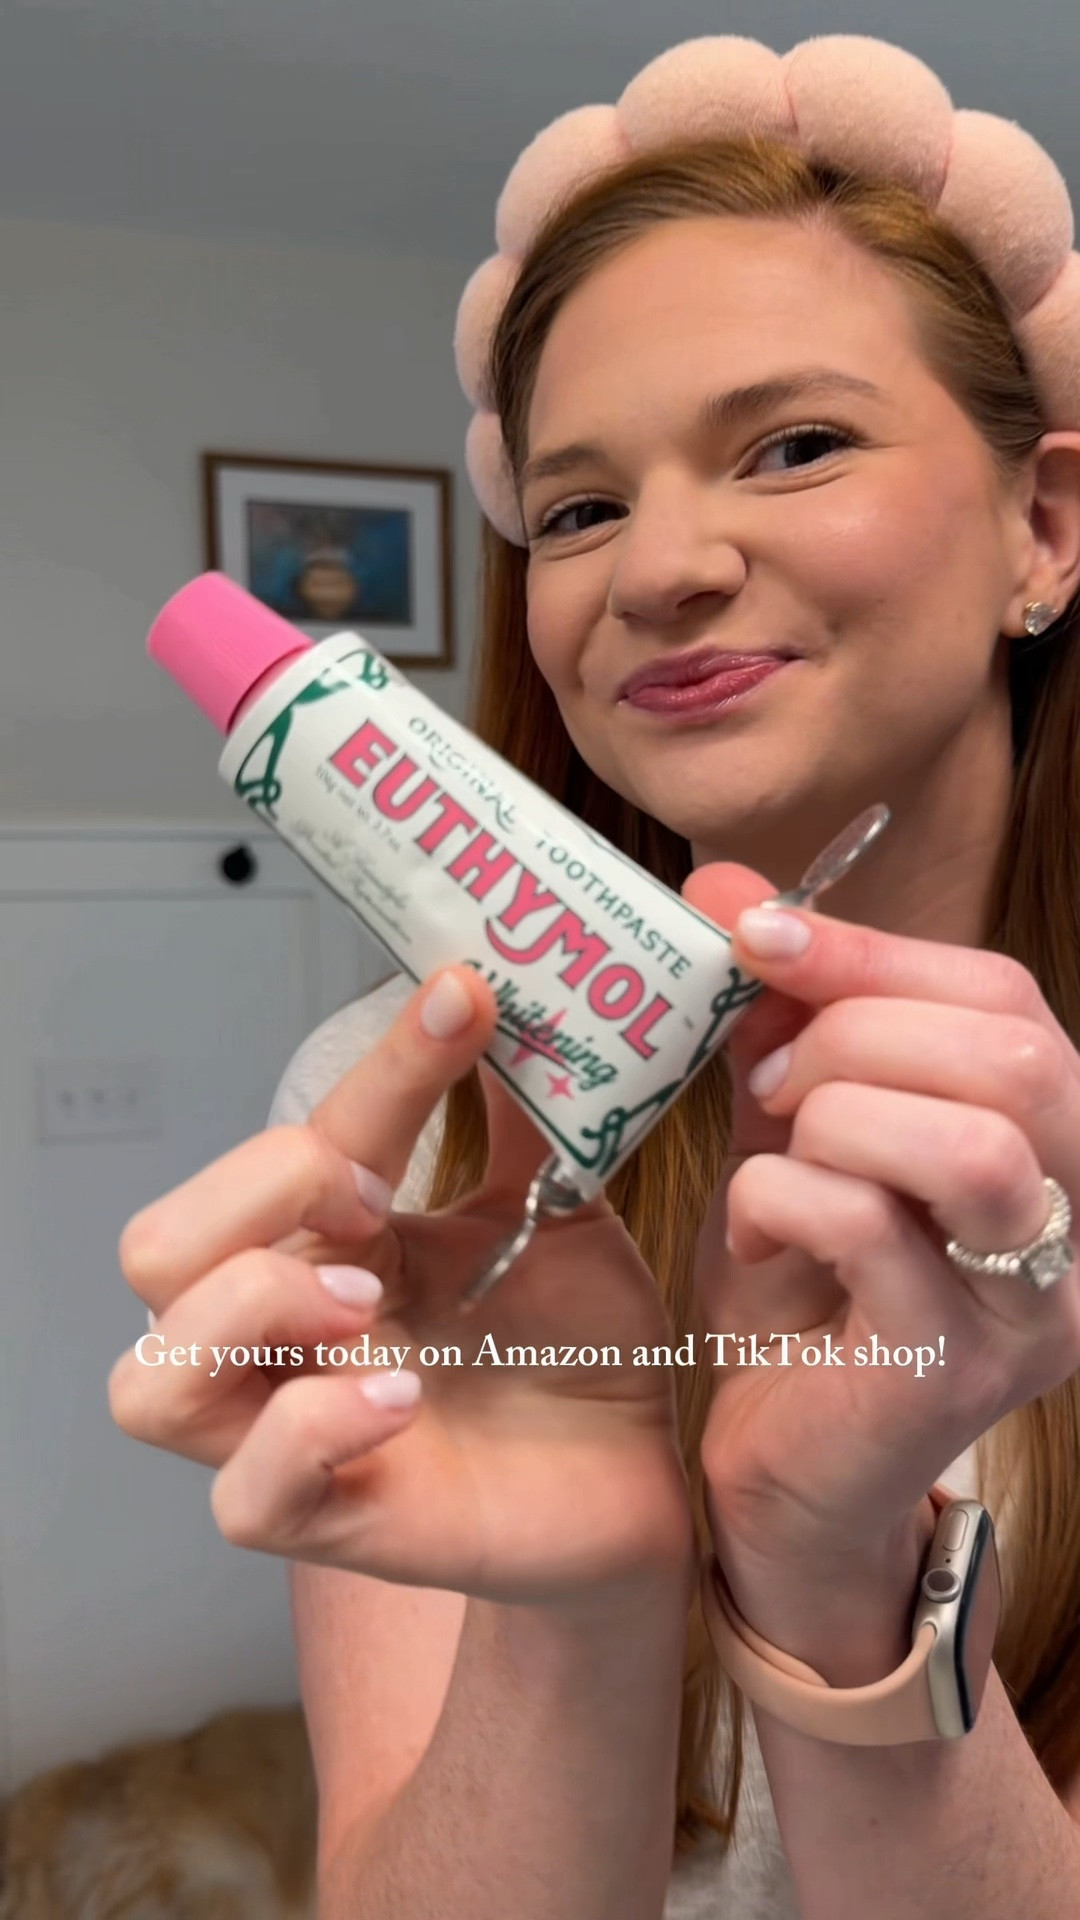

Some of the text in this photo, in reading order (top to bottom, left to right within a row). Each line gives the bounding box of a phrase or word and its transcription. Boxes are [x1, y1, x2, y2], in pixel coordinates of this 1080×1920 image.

[327, 718, 674, 1061] EUTHYMOL
[408, 716, 516, 834] ORIGINAL
[534, 830, 693, 981] TOOTHPASTE
